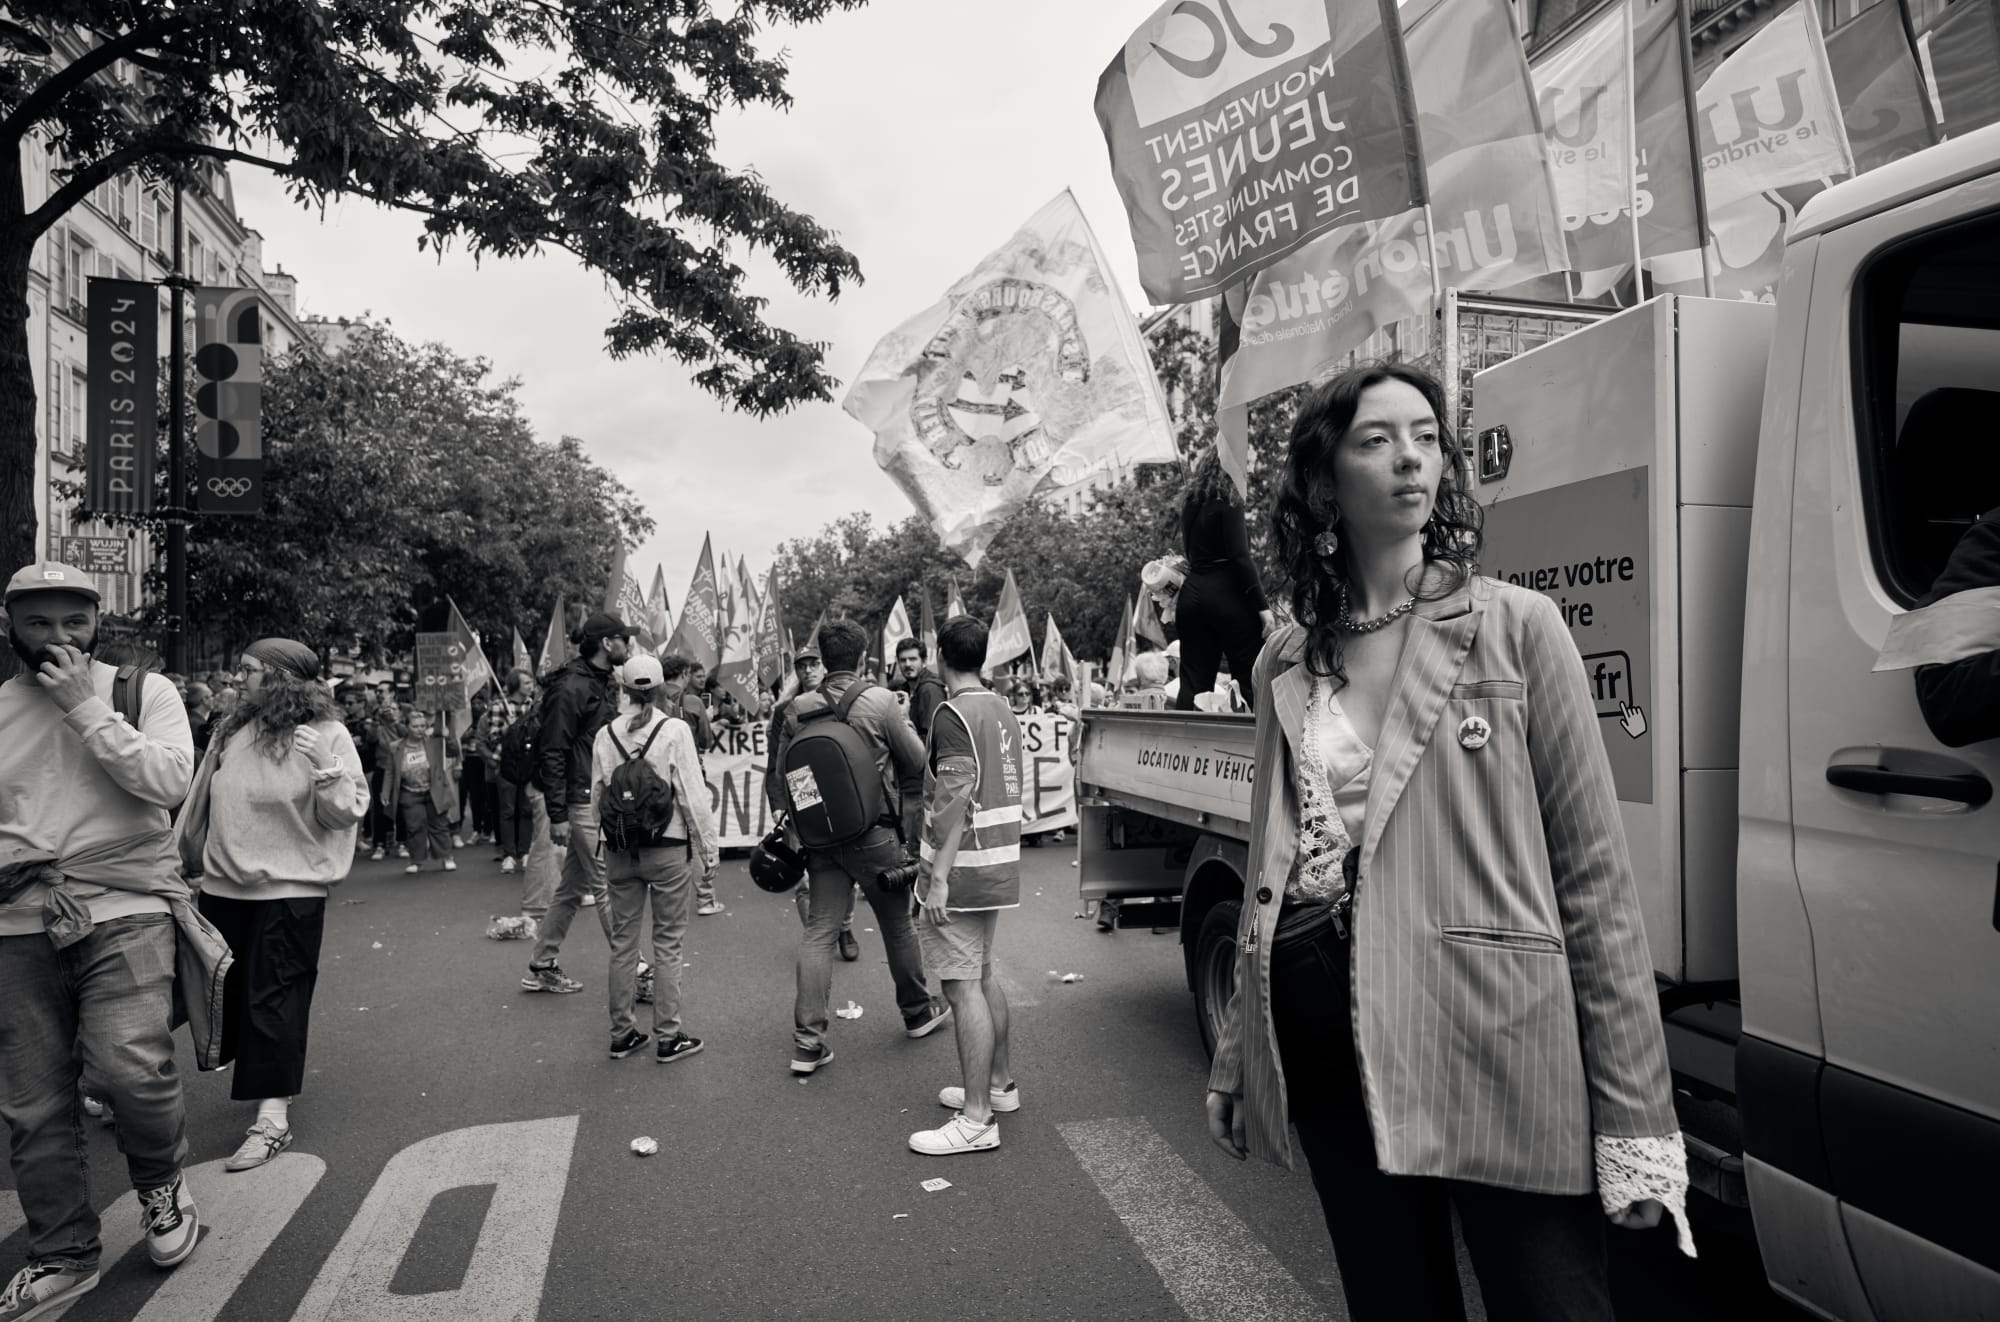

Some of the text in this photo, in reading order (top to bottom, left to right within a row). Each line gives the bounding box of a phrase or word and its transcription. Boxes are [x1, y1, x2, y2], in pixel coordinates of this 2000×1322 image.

[110, 298, 136, 384] 2024
[89, 539, 125, 549] WUJIN
[1564, 556, 1634, 588] votre
[1137, 748, 1189, 773] LOCATION
[1193, 758, 1210, 776] DE
